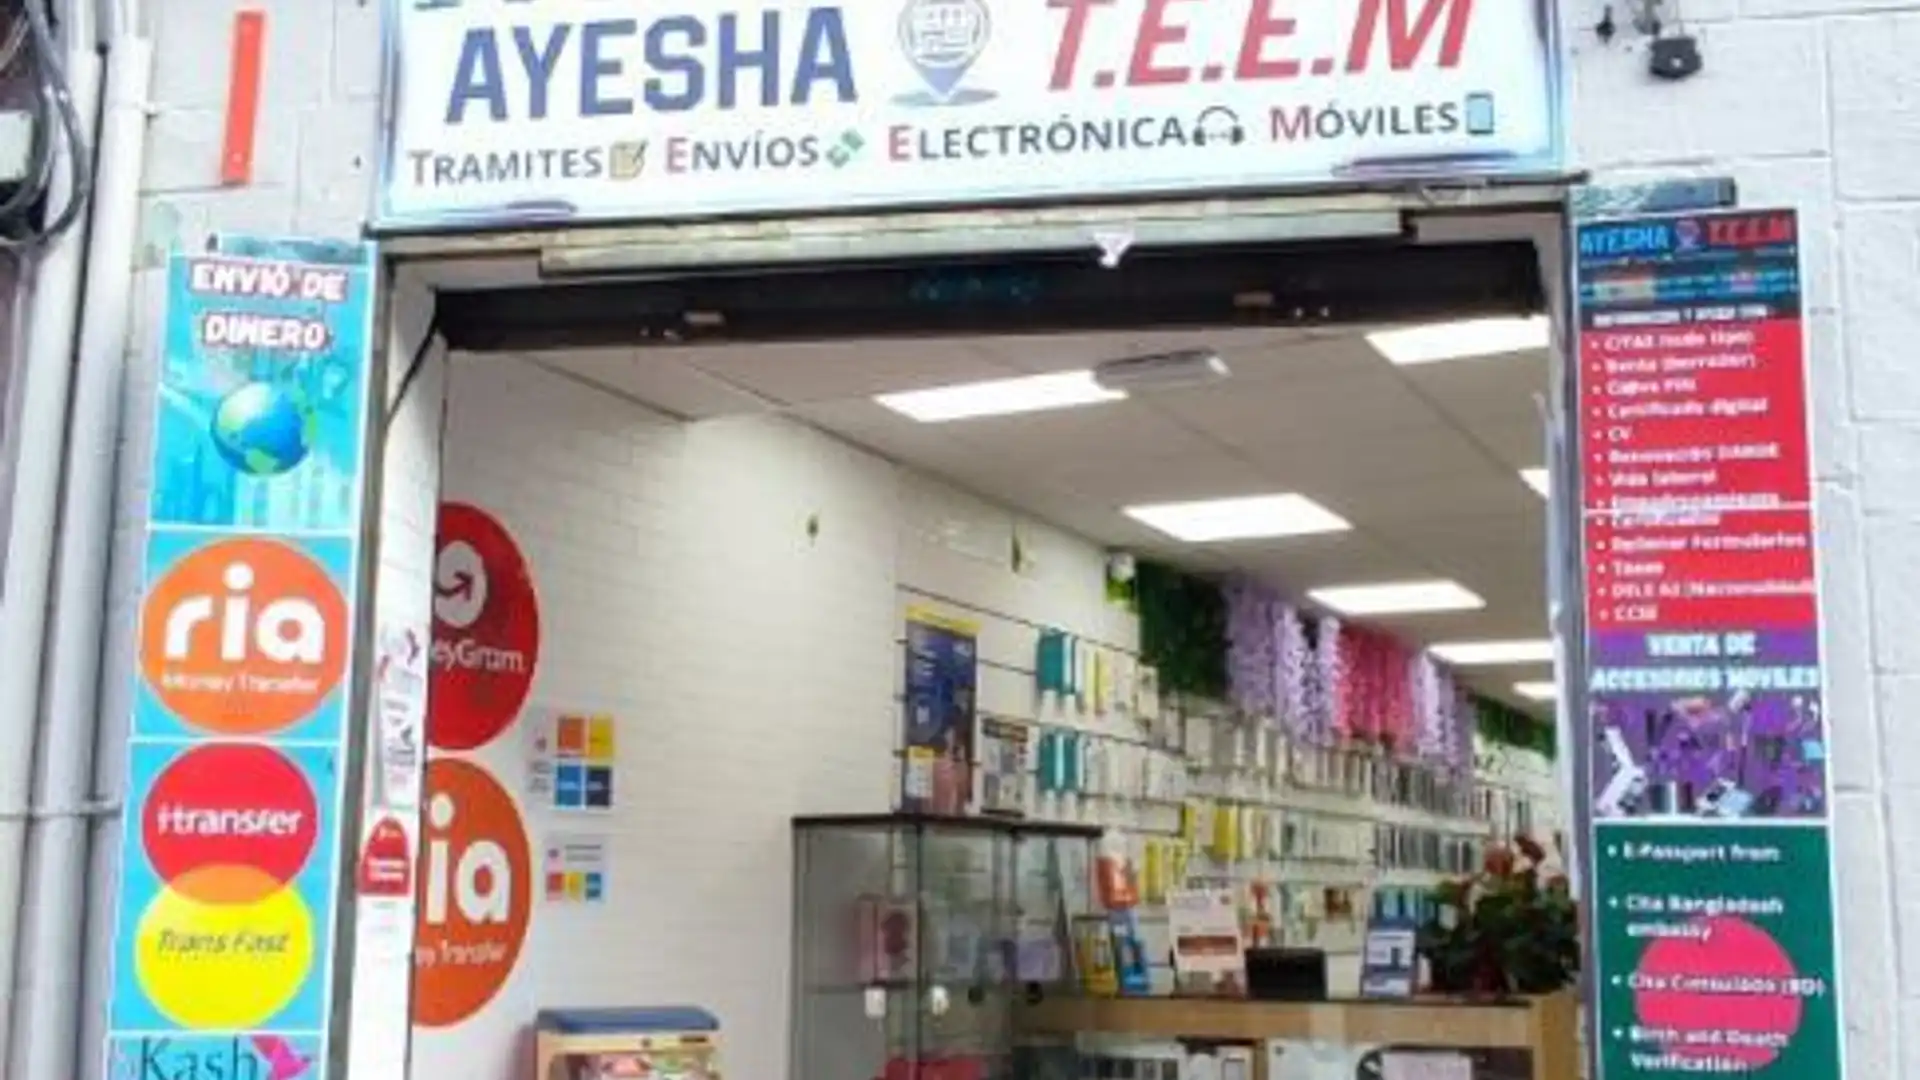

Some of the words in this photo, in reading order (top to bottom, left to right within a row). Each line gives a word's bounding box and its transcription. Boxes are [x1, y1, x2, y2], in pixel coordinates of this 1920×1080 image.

[444, 5, 858, 123] AYESHA
[1045, 0, 1475, 91] T.E.E.M
[408, 146, 603, 187] TRAMITES
[664, 134, 819, 173] ENVÍOS
[888, 114, 1188, 161] ELECTRÓNICA
[1269, 101, 1460, 143] MÓVILES
[303, 270, 348, 301] DE
[205, 314, 328, 350] DINERO
[165, 561, 326, 664] ria
[1647, 633, 1720, 657] VENTA
[1724, 631, 1756, 655] DE
[237, 670, 322, 694] Transfer
[425, 792, 512, 924] ia
[1667, 894, 1785, 917] Bangladesh
[158, 929, 228, 954] Trans
[231, 929, 291, 954] Fast
[1626, 922, 1713, 943] embassy
[1628, 1025, 1681, 1046] Birth
[1685, 1030, 1722, 1045] and
[1725, 1029, 1789, 1048] Death
[140, 1035, 259, 1080] Kash
[1629, 1051, 1749, 1073] Verification
